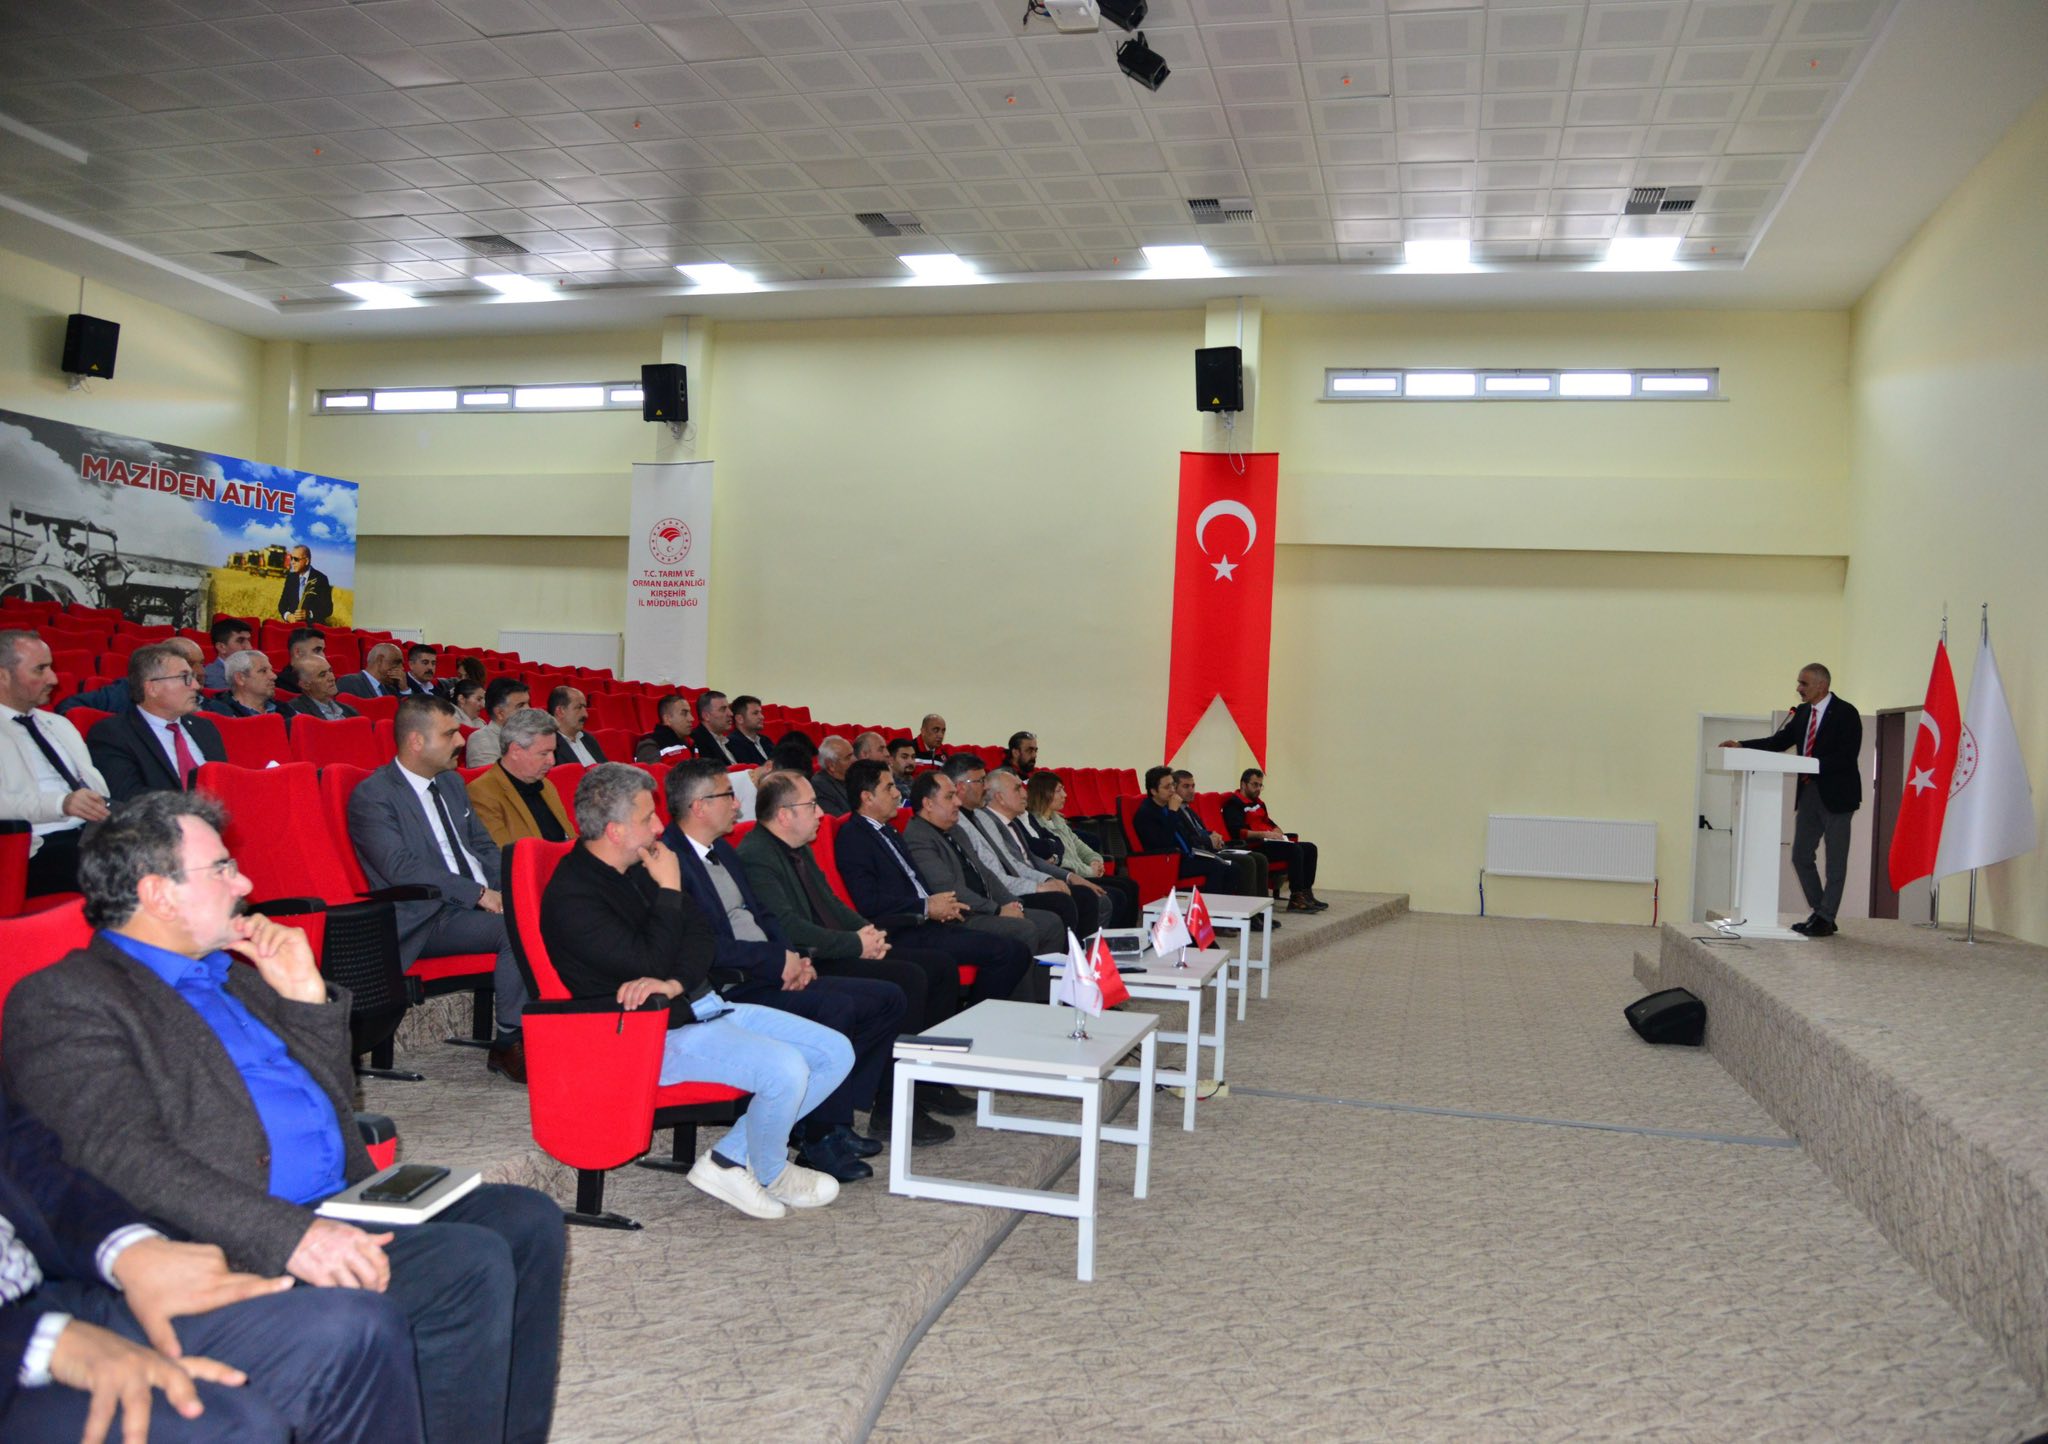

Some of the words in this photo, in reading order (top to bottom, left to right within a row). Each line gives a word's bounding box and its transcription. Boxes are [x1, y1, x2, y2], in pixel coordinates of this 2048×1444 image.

[82, 454, 216, 501] MAZİDEN
[221, 481, 296, 515] ATİYE
[644, 570, 657, 578] T.C.
[660, 570, 684, 578] TARIM
[632, 579, 662, 588] ORMAN
[663, 579, 705, 587] BAKANLIĞI
[650, 589, 687, 598] KIRŞEHİR
[638, 598, 645, 607] İL
[646, 598, 698, 607] MÜDÜRLÜĞÜ
